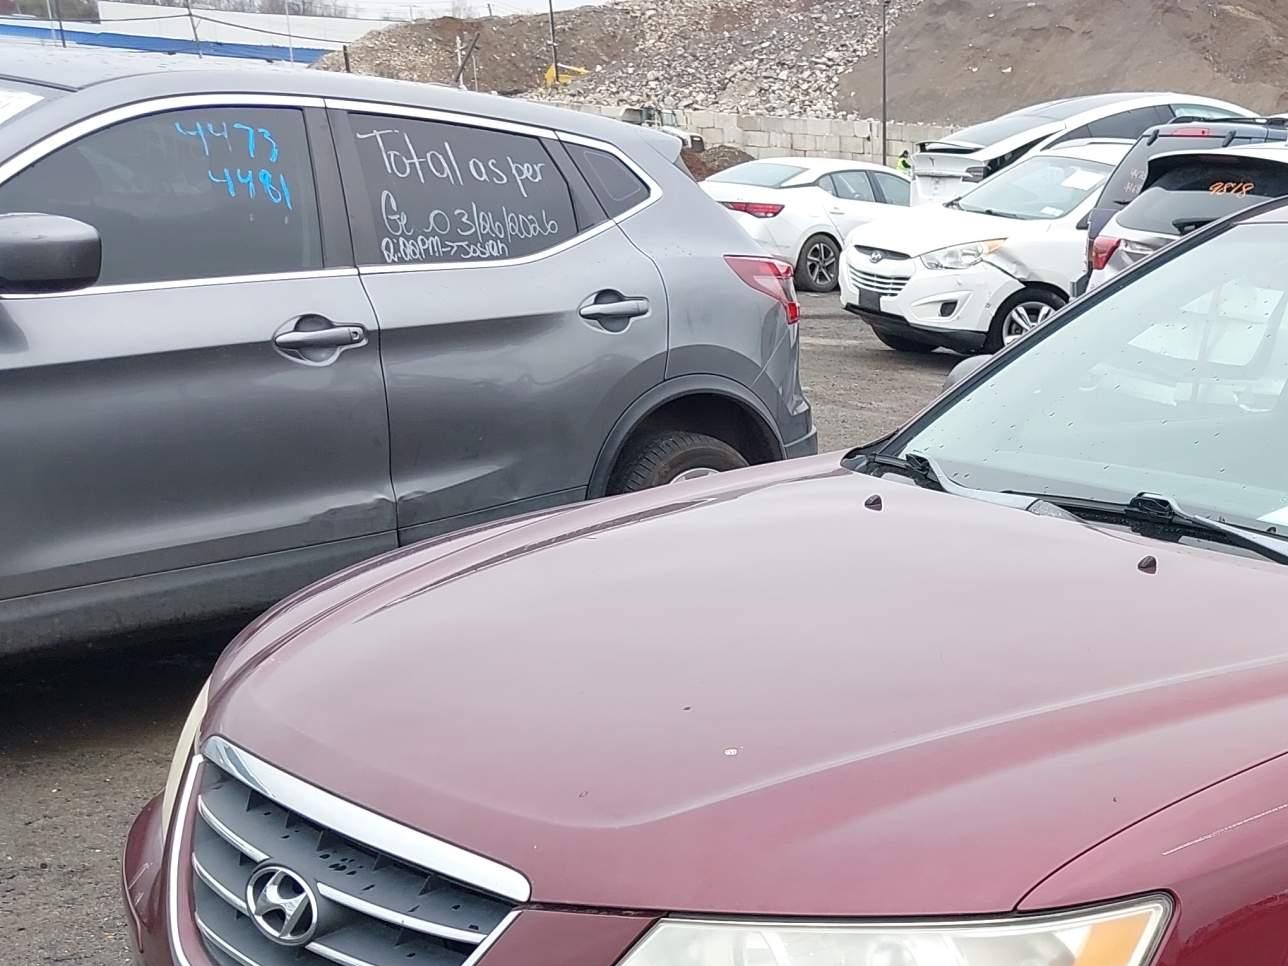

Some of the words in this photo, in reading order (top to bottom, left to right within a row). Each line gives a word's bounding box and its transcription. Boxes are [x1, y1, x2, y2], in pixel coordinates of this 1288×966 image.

[175, 121, 278, 162] 4473
[356, 129, 464, 185] Total
[469, 158, 508, 184] as
[507, 156, 545, 197] per
[208, 167, 292, 210] 4481
